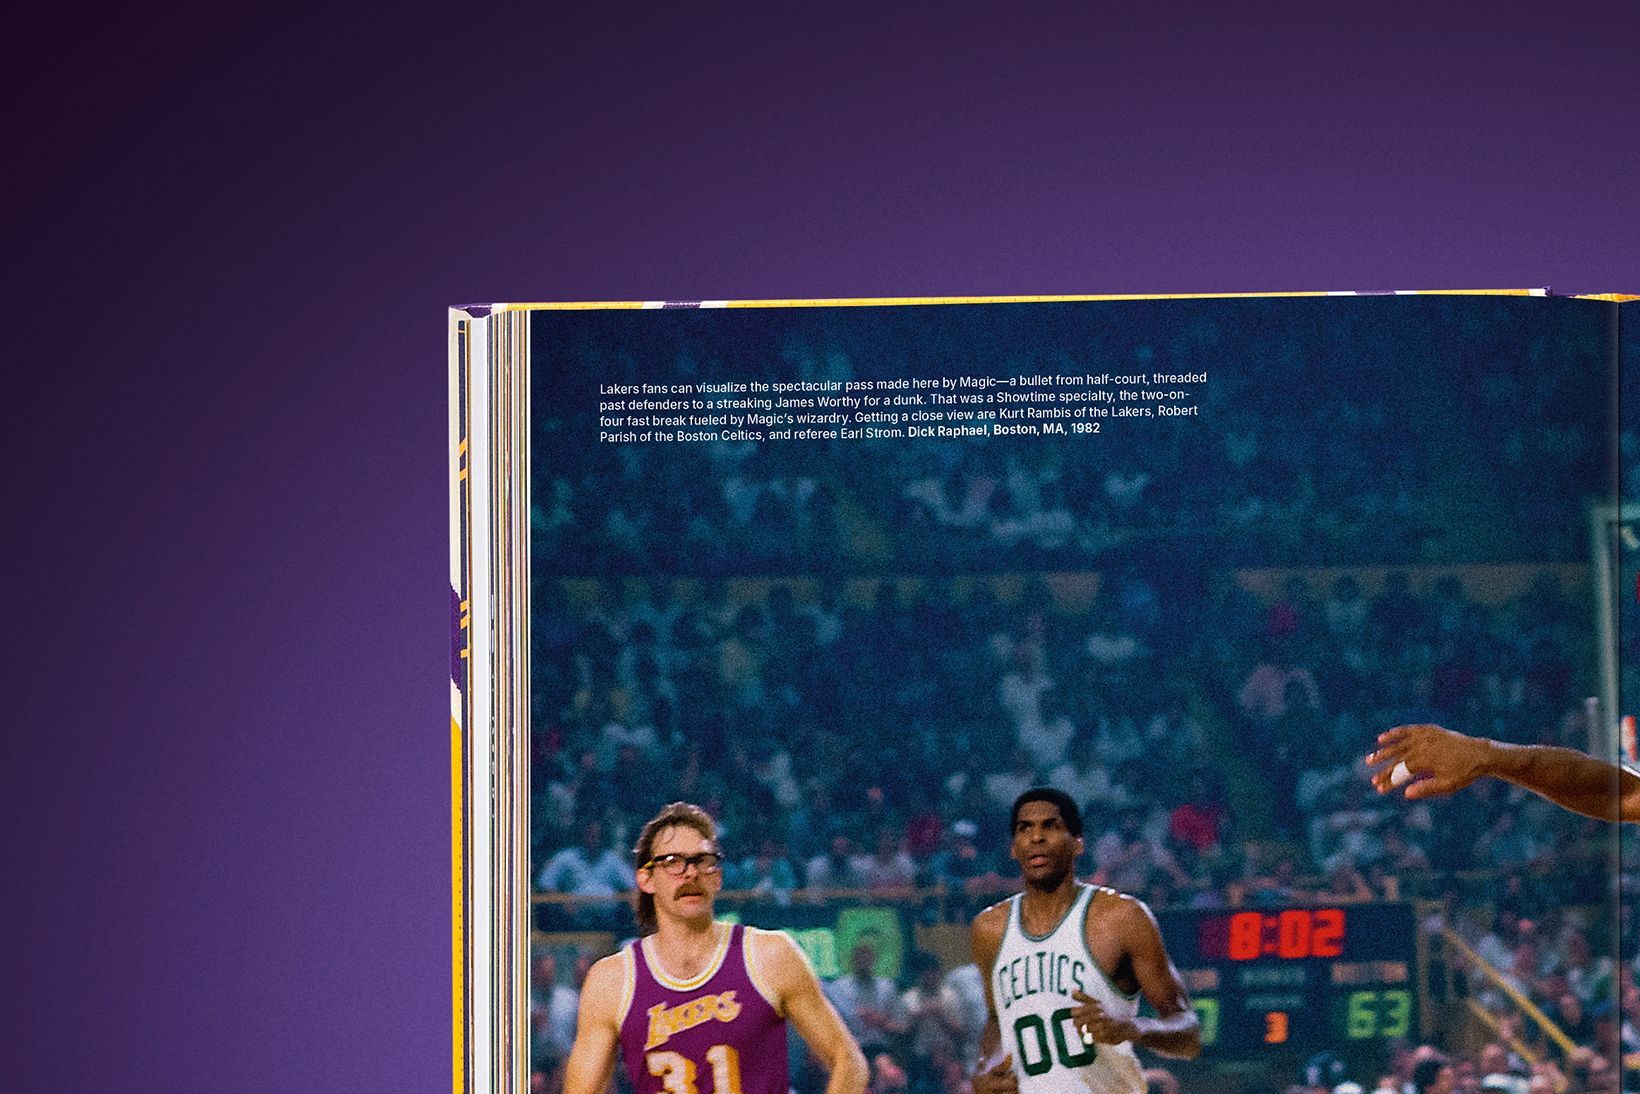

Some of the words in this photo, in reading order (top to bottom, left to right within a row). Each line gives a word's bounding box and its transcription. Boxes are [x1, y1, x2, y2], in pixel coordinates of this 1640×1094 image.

[600, 382, 640, 395] Lakers
[641, 383, 668, 394] fans
[670, 384, 693, 394] can
[695, 381, 747, 394] visualize
[750, 381, 769, 393] the
[772, 380, 843, 394] spectacular
[845, 381, 874, 394] pass
[876, 377, 910, 390] made
[912, 377, 940, 389] here
[942, 377, 957, 391] by
[1019, 375, 1053, 387] bullet
[1055, 374, 1084, 386] from
[1086, 373, 1150, 386] half-court,
[1153, 371, 1207, 384] threaded
[599, 399, 626, 413] past
[628, 398, 690, 411] defenders
[691, 399, 704, 410] to
[706, 400, 714, 410] a
[716, 397, 772, 411] streaking
[775, 396, 815, 408] James
[817, 396, 861, 409] Worthy
[863, 395, 881, 407] for
[883, 397, 891, 406] a
[893, 393, 927, 406] dunk.
[930, 393, 957, 405] That
[959, 394, 984, 404] was
[986, 394, 994, 404] a
[996, 391, 1056, 403] Showtime
[1059, 389, 1116, 404] specialty,
[1119, 389, 1138, 401] the
[1141, 389, 1190, 400] two-on-
[599, 415, 625, 427] four
[626, 415, 650, 427] fast
[652, 414, 687, 427] break
[688, 413, 727, 426] fueled
[730, 414, 745, 428] by
[796, 412, 852, 426] wizardry.
[854, 411, 899, 425] Getting
[901, 412, 909, 422] a
[911, 410, 944, 422] close
[946, 409, 974, 420] view
[977, 410, 996, 420] are
[999, 407, 1025, 419] Kurt
[1027, 406, 1072, 419] Rambis
[1073, 406, 1087, 418] of
[1088, 406, 1109, 417] the
[1111, 406, 1155, 419] Lakers,
[1158, 405, 1198, 417] Robert
[600, 431, 637, 443] Parish
[639, 431, 652, 442] of
[654, 431, 674, 442] the
[677, 430, 718, 442] Boston
[721, 429, 765, 442] Celtics,
[768, 428, 791, 440] and
[794, 427, 838, 440] referee
[840, 427, 863, 440] Earl
[865, 427, 905, 439] Strom.
[908, 425, 936, 438] Dick
[937, 424, 991, 439] Raphael,
[993, 423, 1040, 437] Boston,
[1043, 422, 1068, 436] MA,
[1070, 421, 1100, 434] 1982
[1229, 908, 1345, 961] 8:02
[999, 951, 1085, 1009] CELTICS
[1348, 991, 1412, 1038] 63
